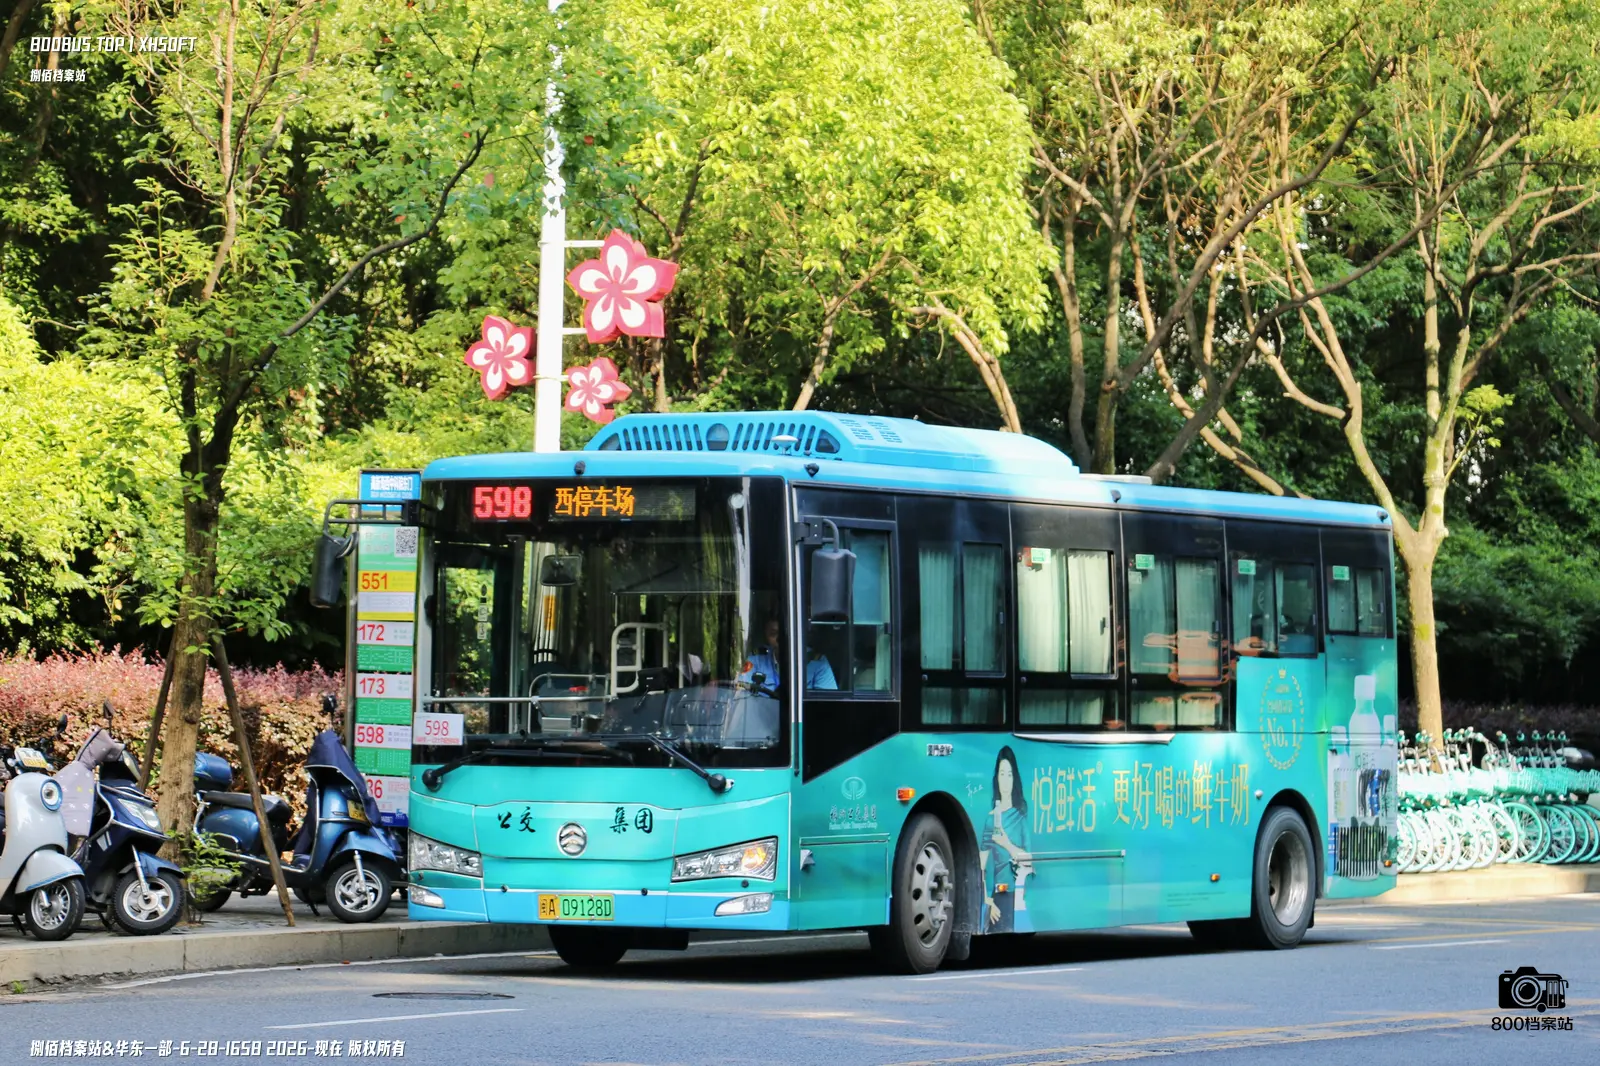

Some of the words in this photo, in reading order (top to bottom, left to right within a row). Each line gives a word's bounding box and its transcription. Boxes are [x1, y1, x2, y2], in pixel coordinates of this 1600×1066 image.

[474, 486, 532, 518] 598
[555, 486, 635, 517] 西停车场
[361, 573, 388, 590] 551
[357, 623, 385, 641] 172
[359, 678, 385, 694] 173
[357, 726, 384, 744] 598
[425, 720, 449, 736] 598
[1031, 765, 1097, 834] 悦鲜活
[1112, 759, 1250, 830] 更好喝的鲜牛奶
[497, 806, 536, 833] 公交
[610, 806, 653, 834] 集团
